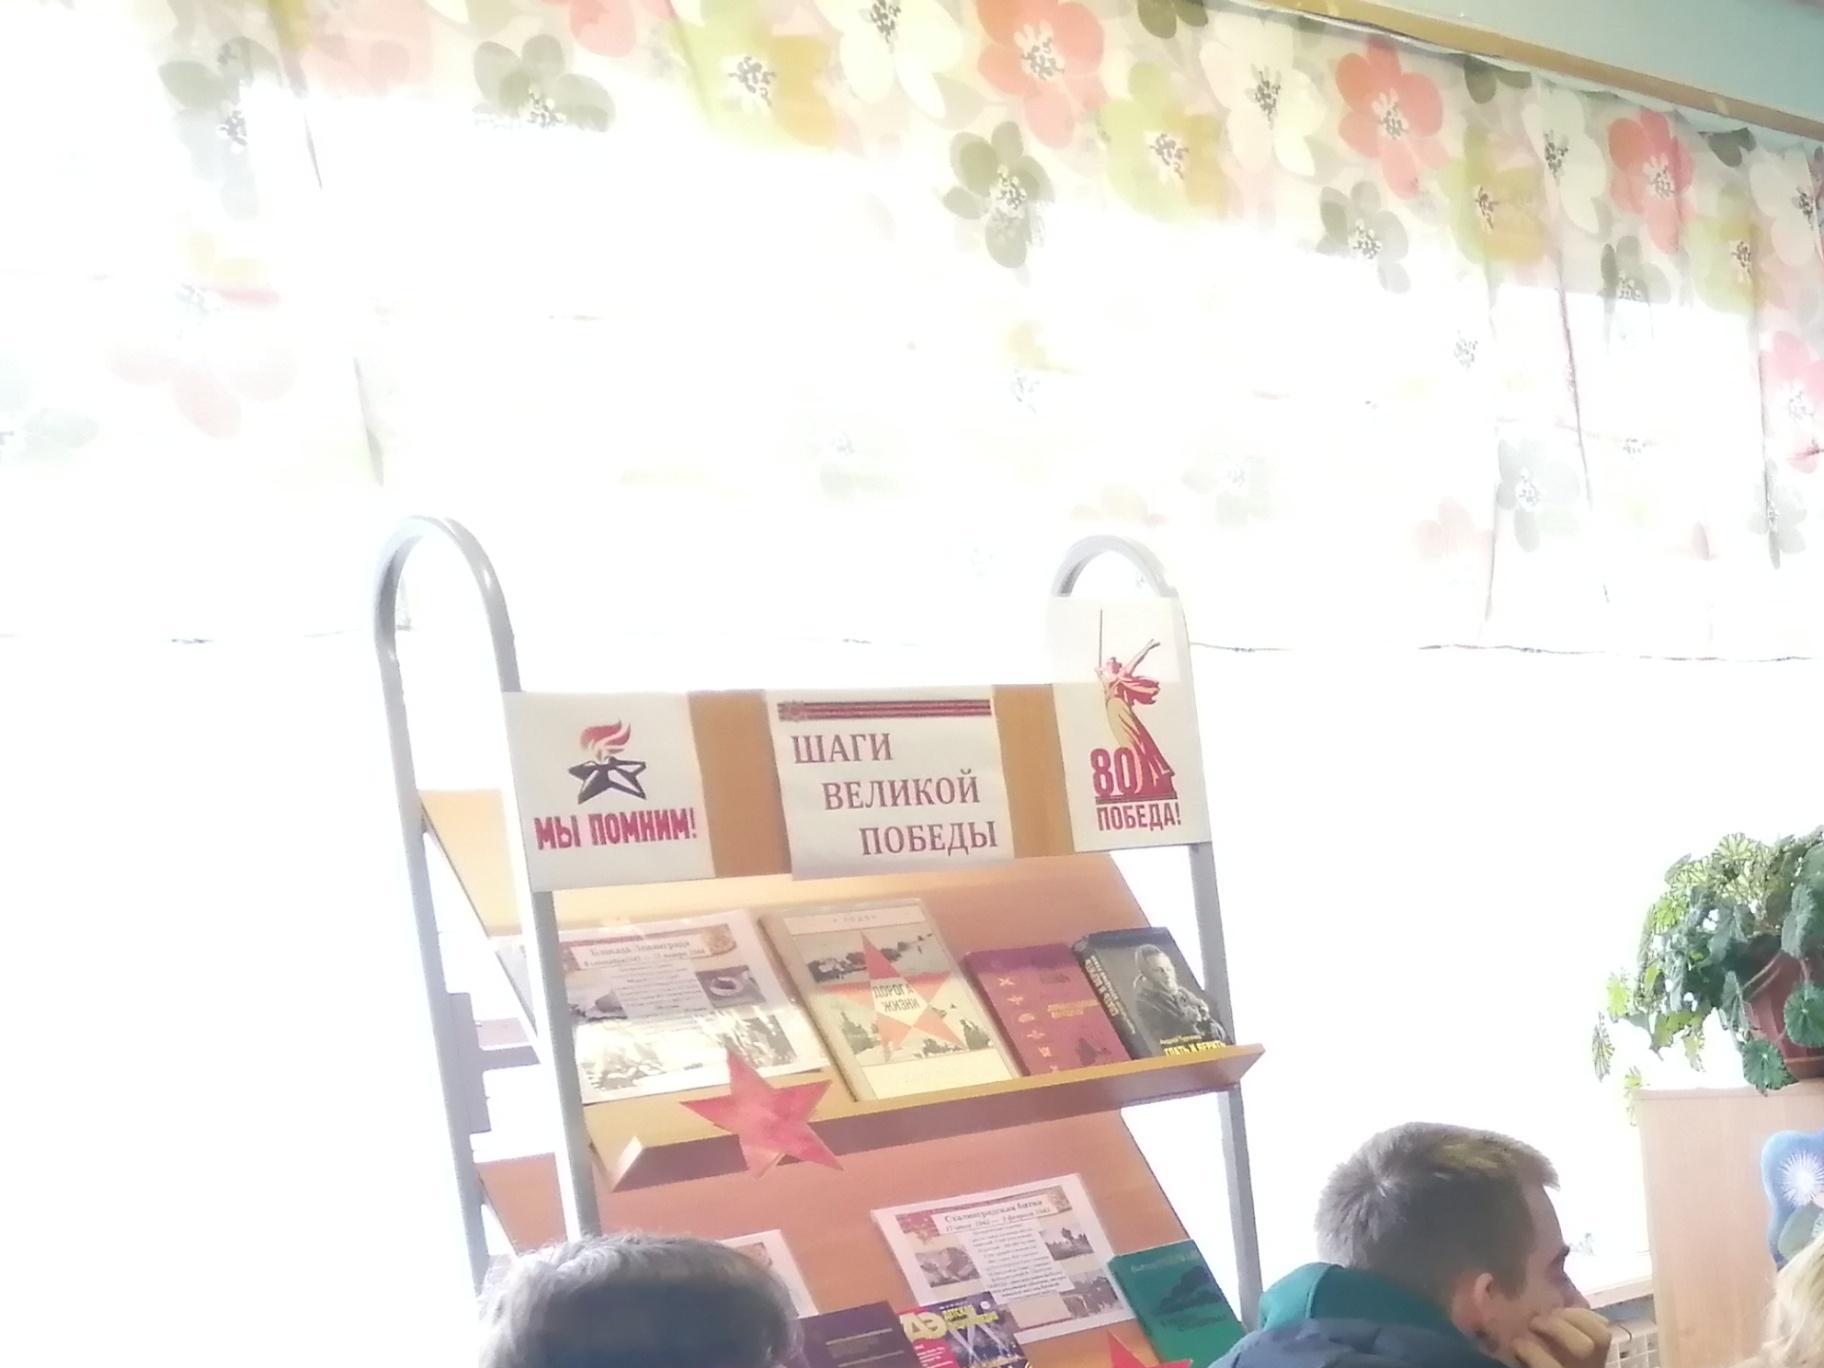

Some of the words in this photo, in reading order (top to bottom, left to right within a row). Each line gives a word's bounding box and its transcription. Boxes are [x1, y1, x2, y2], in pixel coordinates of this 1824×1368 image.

[790, 732, 893, 764] ШАГИ
[822, 768, 980, 810] ВЕЛИКОЙ
[1090, 746, 1140, 797] 80
[534, 815, 581, 850] МЫ
[587, 807, 697, 847] ПОМНИМ!
[1096, 802, 1181, 832] ПОБЕДА!
[859, 821, 998, 857] ПОБЕДЫ
